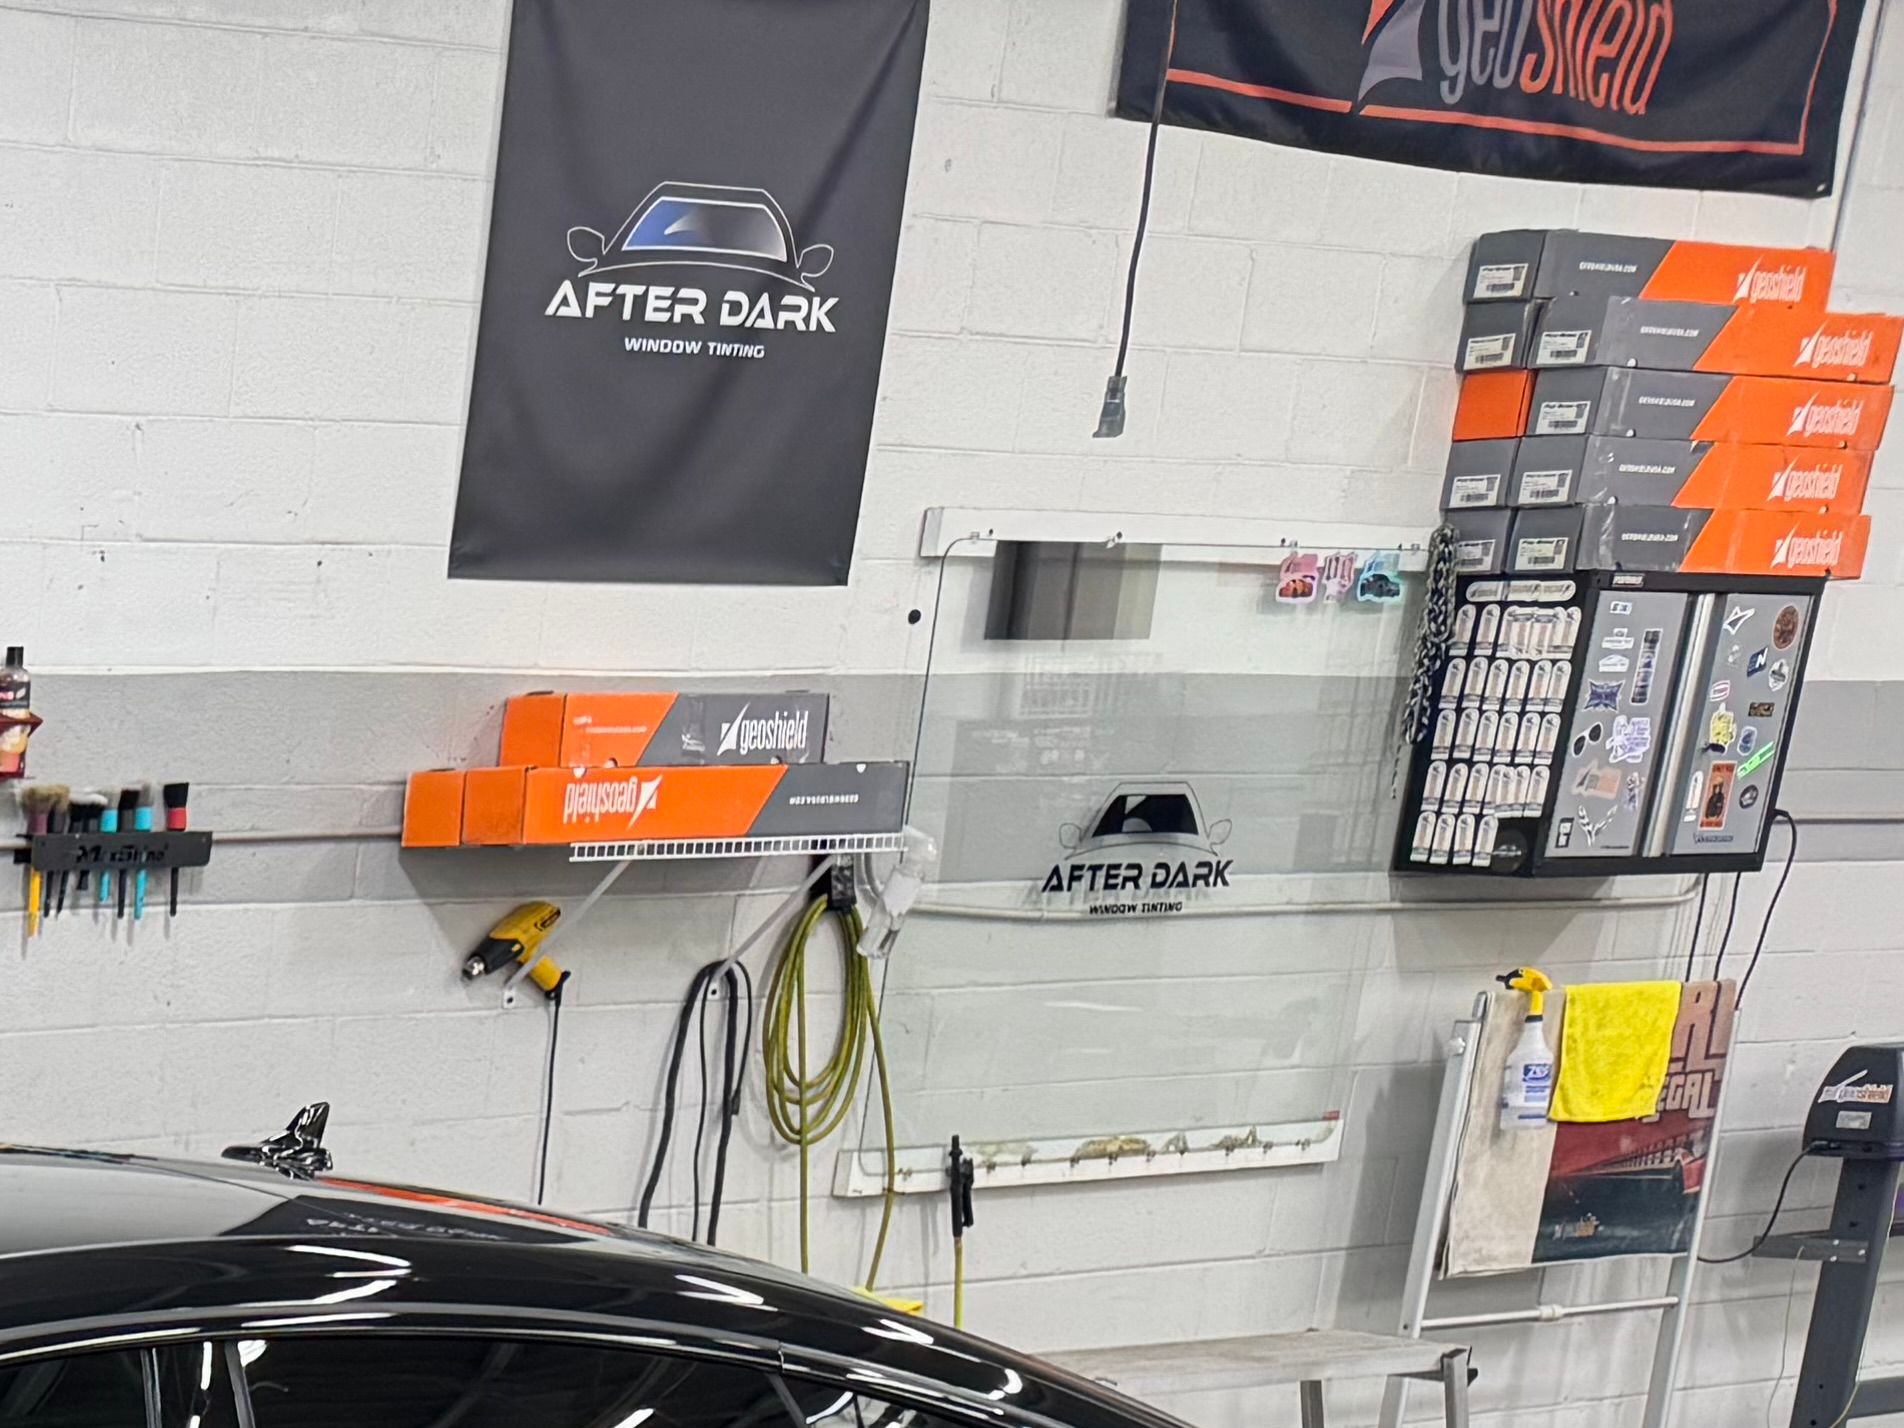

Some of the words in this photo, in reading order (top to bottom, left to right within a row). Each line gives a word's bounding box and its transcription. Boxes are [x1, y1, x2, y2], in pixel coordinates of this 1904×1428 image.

[1749, 265, 1808, 304] geoshield
[544, 279, 707, 325] AFTER
[719, 290, 840, 332] DARK
[624, 337, 703, 355] WINDOW
[707, 341, 766, 359] TINTING
[1811, 330, 1874, 369] geoshield
[1803, 400, 1865, 438] geoshield
[1783, 463, 1843, 503] geoshield
[1786, 529, 1844, 569] geoshield
[739, 710, 809, 755] geoshield
[563, 775, 639, 824] geoshield
[1042, 863, 1143, 893] AFTER
[1150, 859, 1234, 889] DARK
[1088, 903, 1138, 915] WINDOW
[1141, 902, 1183, 914] TINTING
